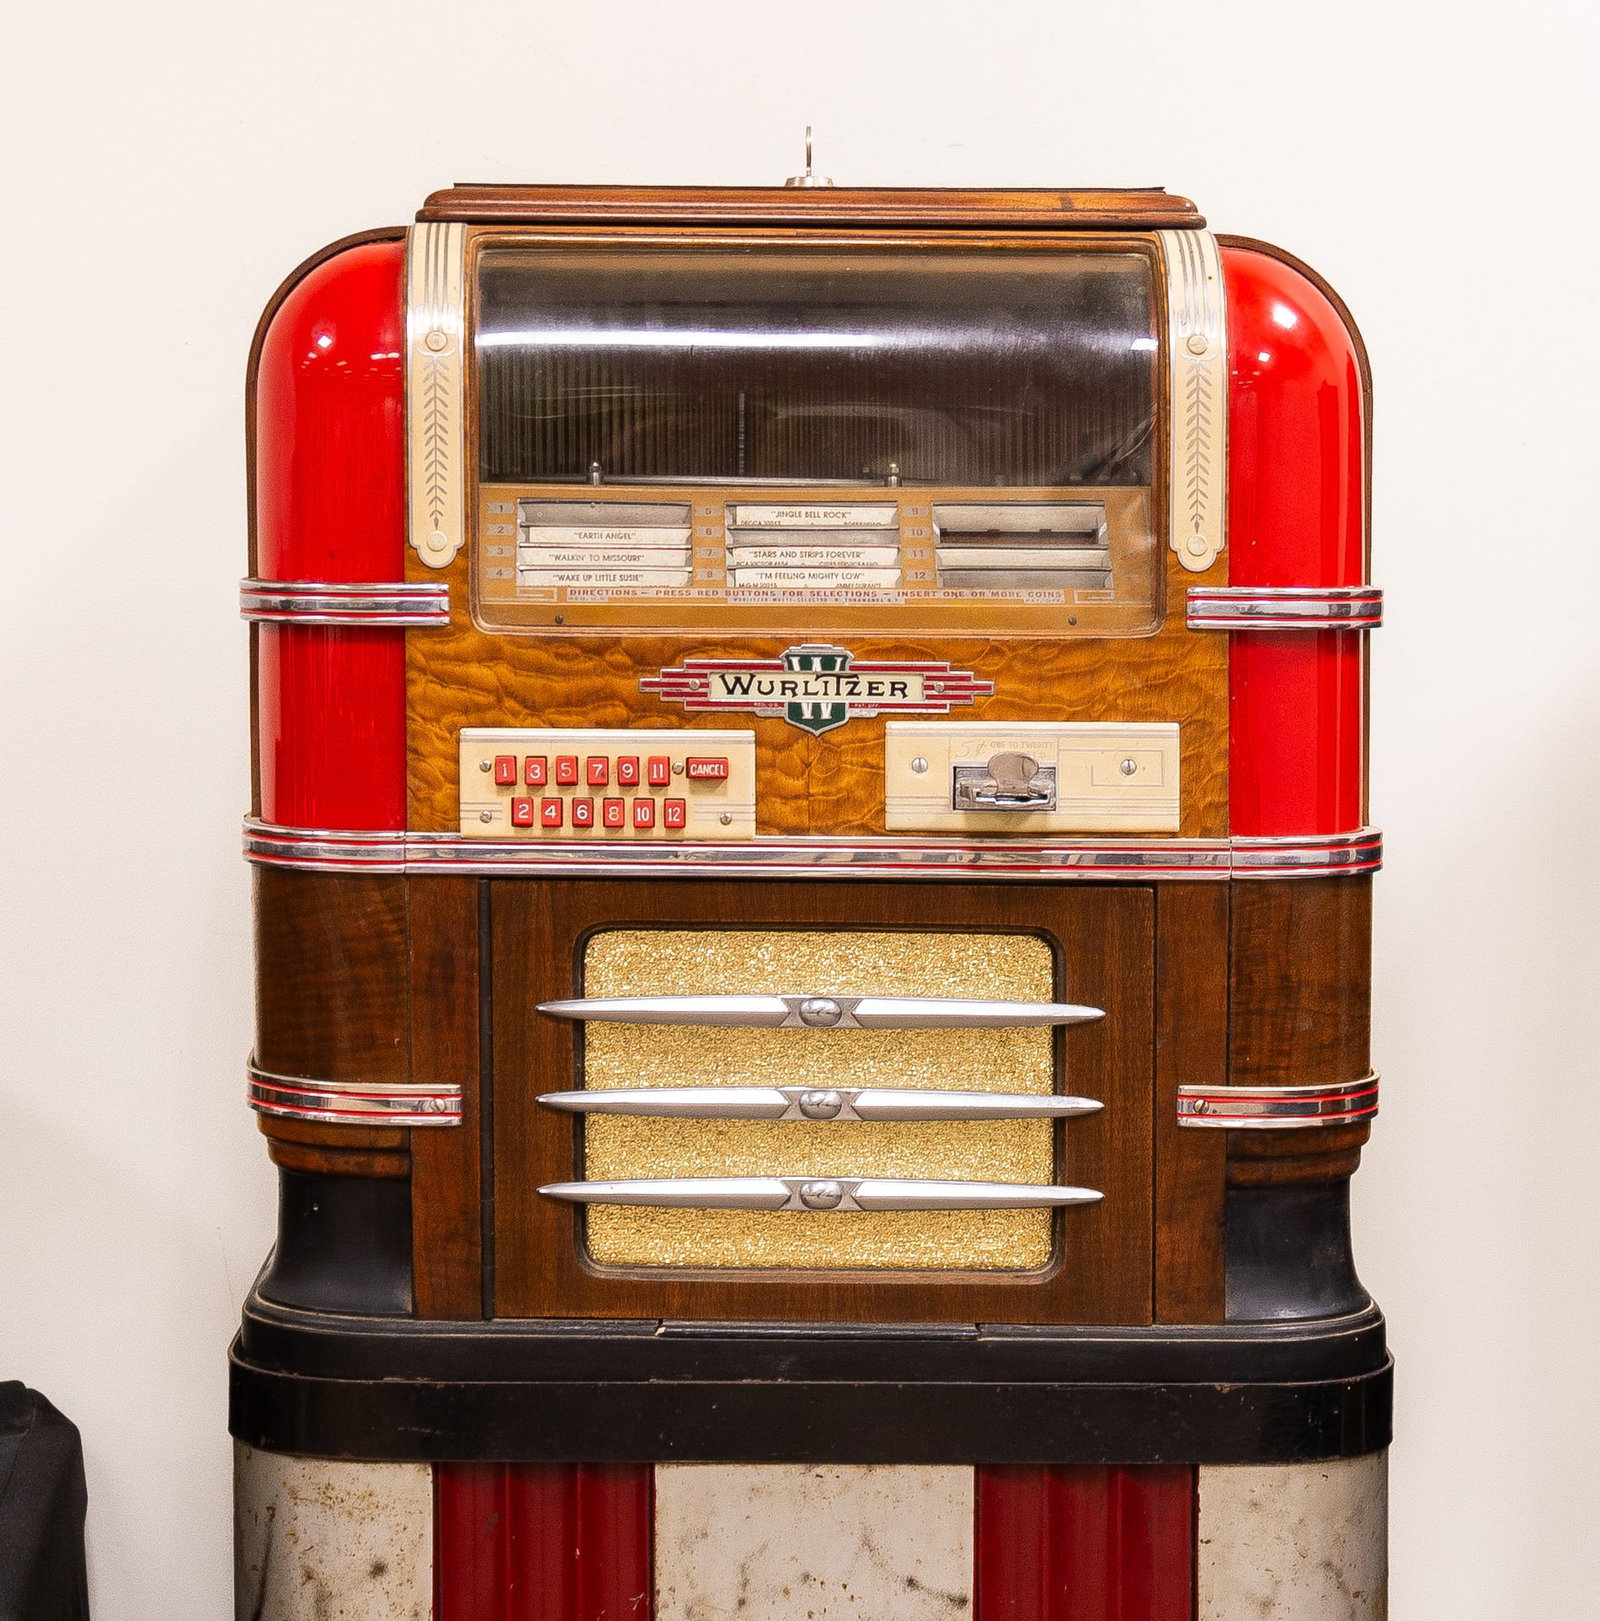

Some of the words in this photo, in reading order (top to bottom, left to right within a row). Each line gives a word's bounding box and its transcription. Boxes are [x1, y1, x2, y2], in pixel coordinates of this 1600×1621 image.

[705, 507, 711, 515] 5
[912, 507, 918, 515] 9
[574, 532, 603, 540] "EARTH
[605, 532, 636, 540] ANGEL"
[911, 528, 923, 536] 10
[602, 554, 645, 562] MISSOURI"
[749, 551, 777, 559] "STARS
[826, 551, 865, 559] FOREVER"
[496, 569, 502, 577] 4
[552, 574, 580, 582] "WAKE
[582, 574, 593, 582] UP
[595, 574, 617, 582] LITTLE
[619, 574, 644, 582] SUSIE"
[706, 570, 713, 578] 8
[775, 572, 806, 580] FEELING
[914, 571, 926, 579] 12
[719, 673, 909, 699] WURLITZER
[529, 764, 541, 779] 3
[560, 762, 572, 777] 5
[592, 763, 603, 776] 7
[622, 763, 633, 777] 9
[652, 763, 664, 778] 11
[689, 764, 725, 776] CANCEL
[518, 804, 529, 819] 2
[544, 805, 556, 818] 4
[576, 804, 588, 820] 6
[608, 806, 619, 821] 8
[637, 807, 649, 822] 10
[668, 807, 681, 822] 12
